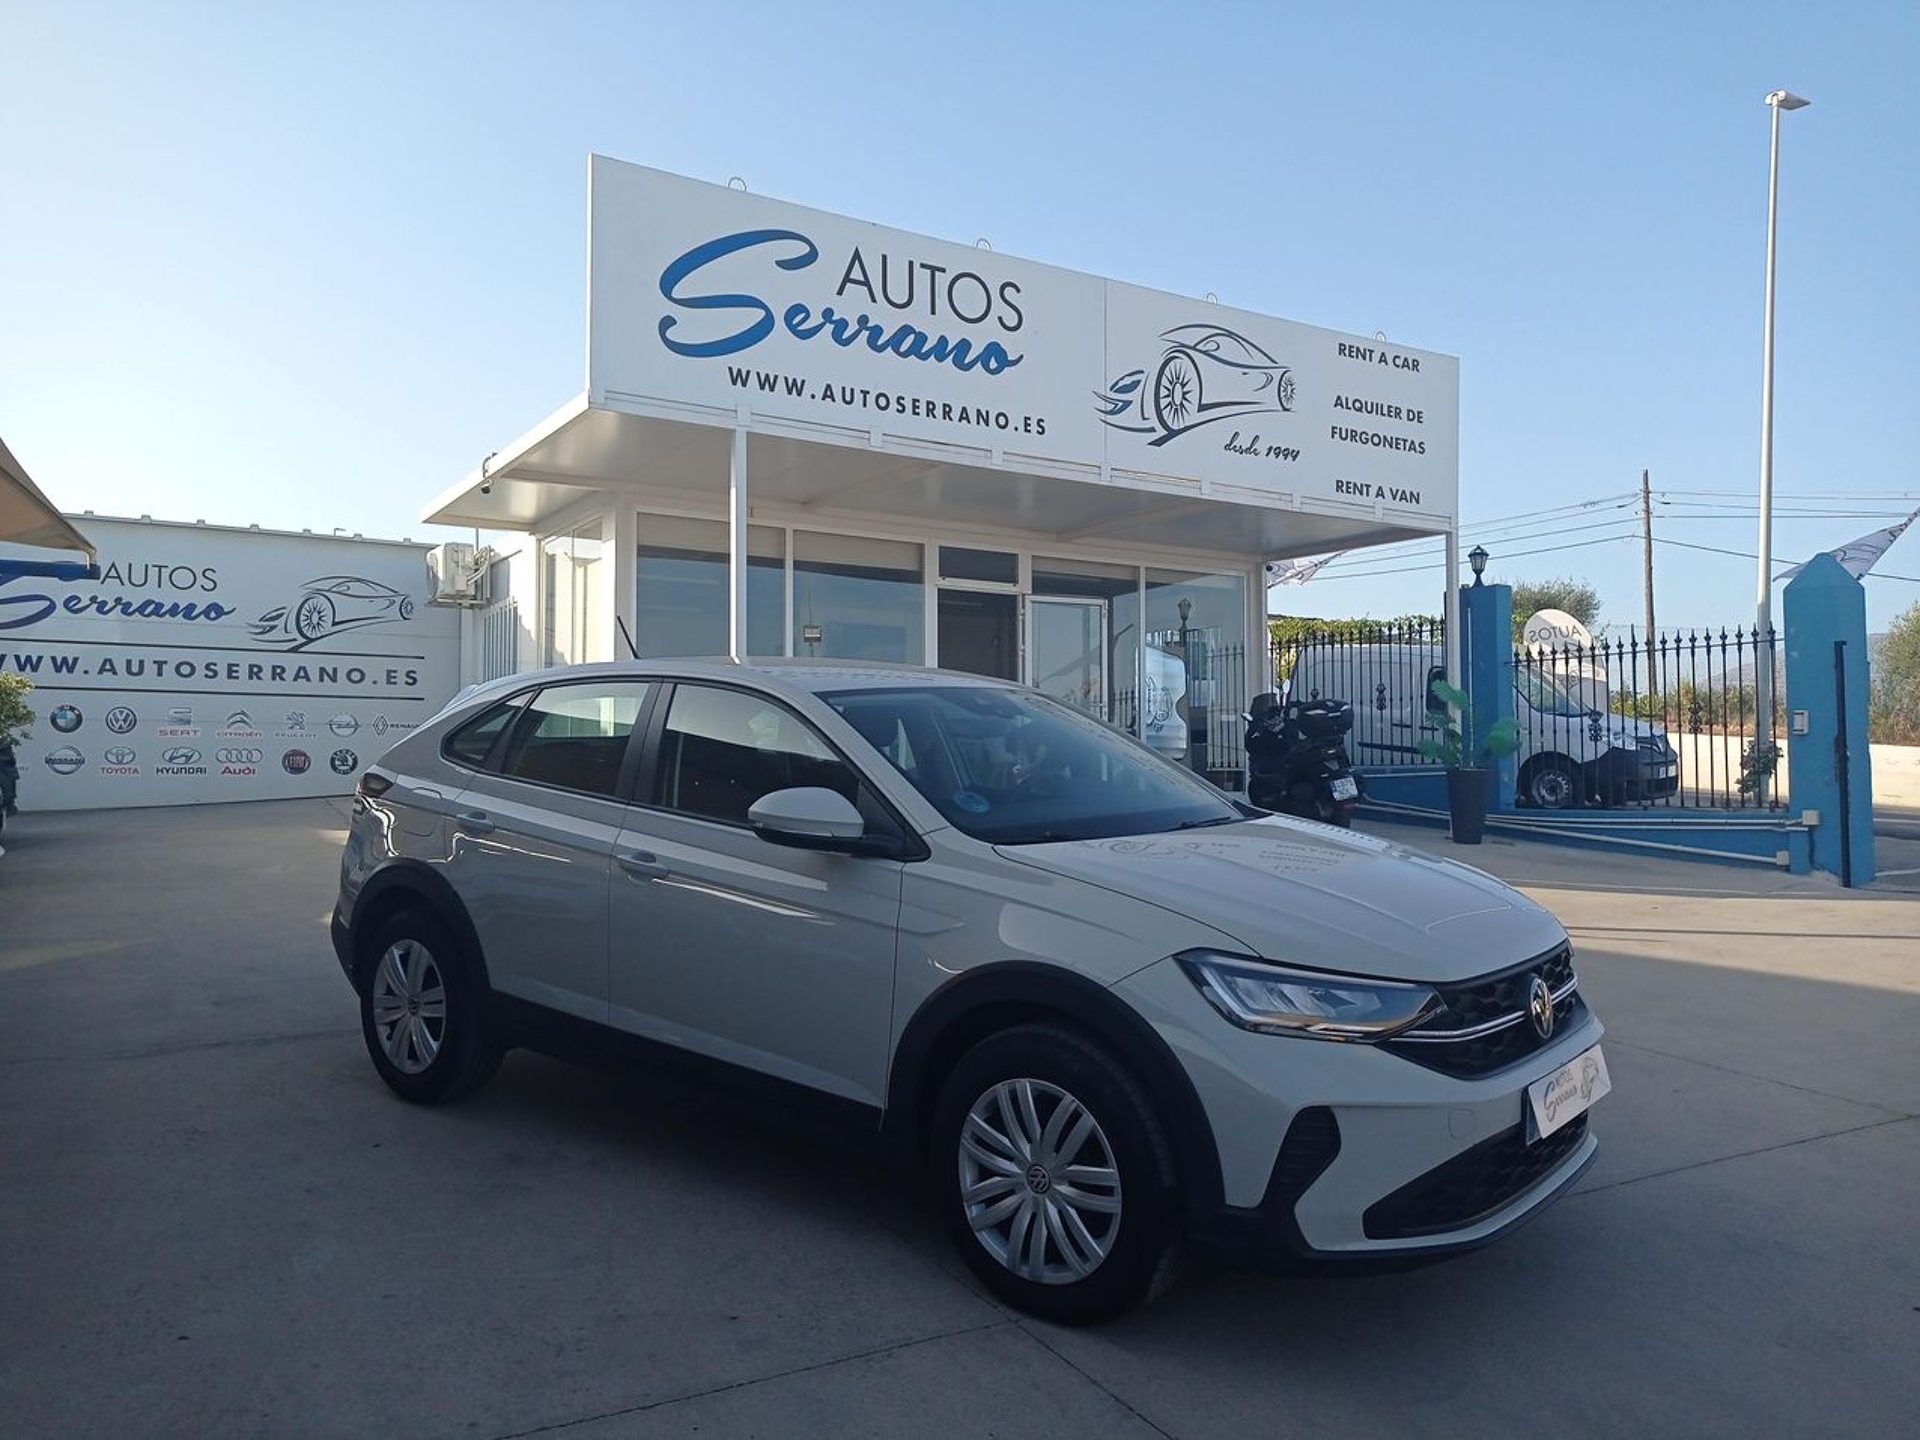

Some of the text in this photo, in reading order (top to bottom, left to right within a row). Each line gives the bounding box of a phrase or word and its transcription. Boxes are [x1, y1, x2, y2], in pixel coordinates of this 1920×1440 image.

[658, 229, 1024, 376] Serrano
[836, 246, 1024, 332] AUTOS
[1337, 342, 1421, 373] RENT A CAR
[727, 366, 1047, 436] WWW.AUTOSERRANO.ES
[1333, 394, 1424, 424] ALQUILER DE
[1224, 431, 1261, 457] desde
[1330, 425, 1426, 455] FURGONETAS
[1334, 479, 1421, 506] RENT A VAN
[100, 561, 218, 592] AUTOS
[0, 653, 419, 687] WW.AUTOSERRANO.ES
[158, 729, 200, 737] SEAT
[100, 767, 140, 775] TOYOTA
[156, 767, 207, 775] HYUNDAI
[220, 766, 257, 776] Audi
